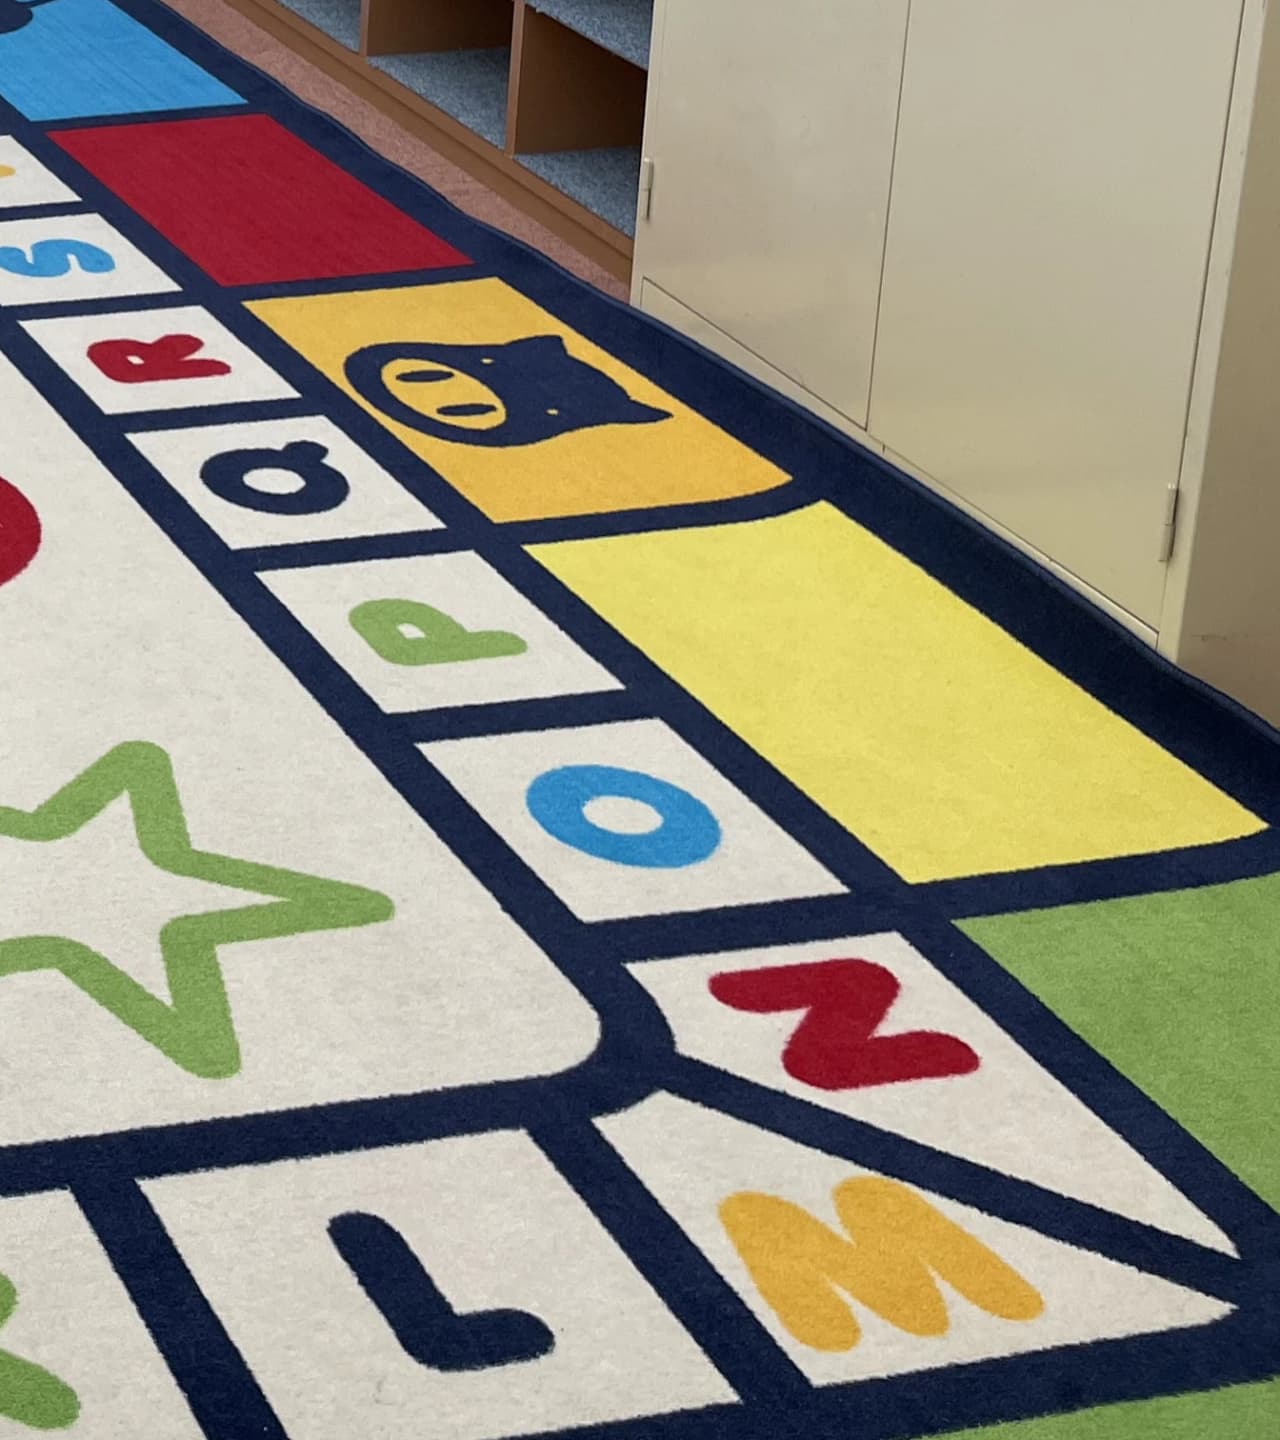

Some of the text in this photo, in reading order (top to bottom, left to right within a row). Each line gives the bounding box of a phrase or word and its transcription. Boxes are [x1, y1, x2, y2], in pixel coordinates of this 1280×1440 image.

[87, 333, 232, 383] R
[199, 439, 351, 516] Q
[346, 597, 529, 667] P
[524, 764, 723, 870] O
[326, 1210, 555, 1373] L
[715, 1174, 1046, 1354] M
